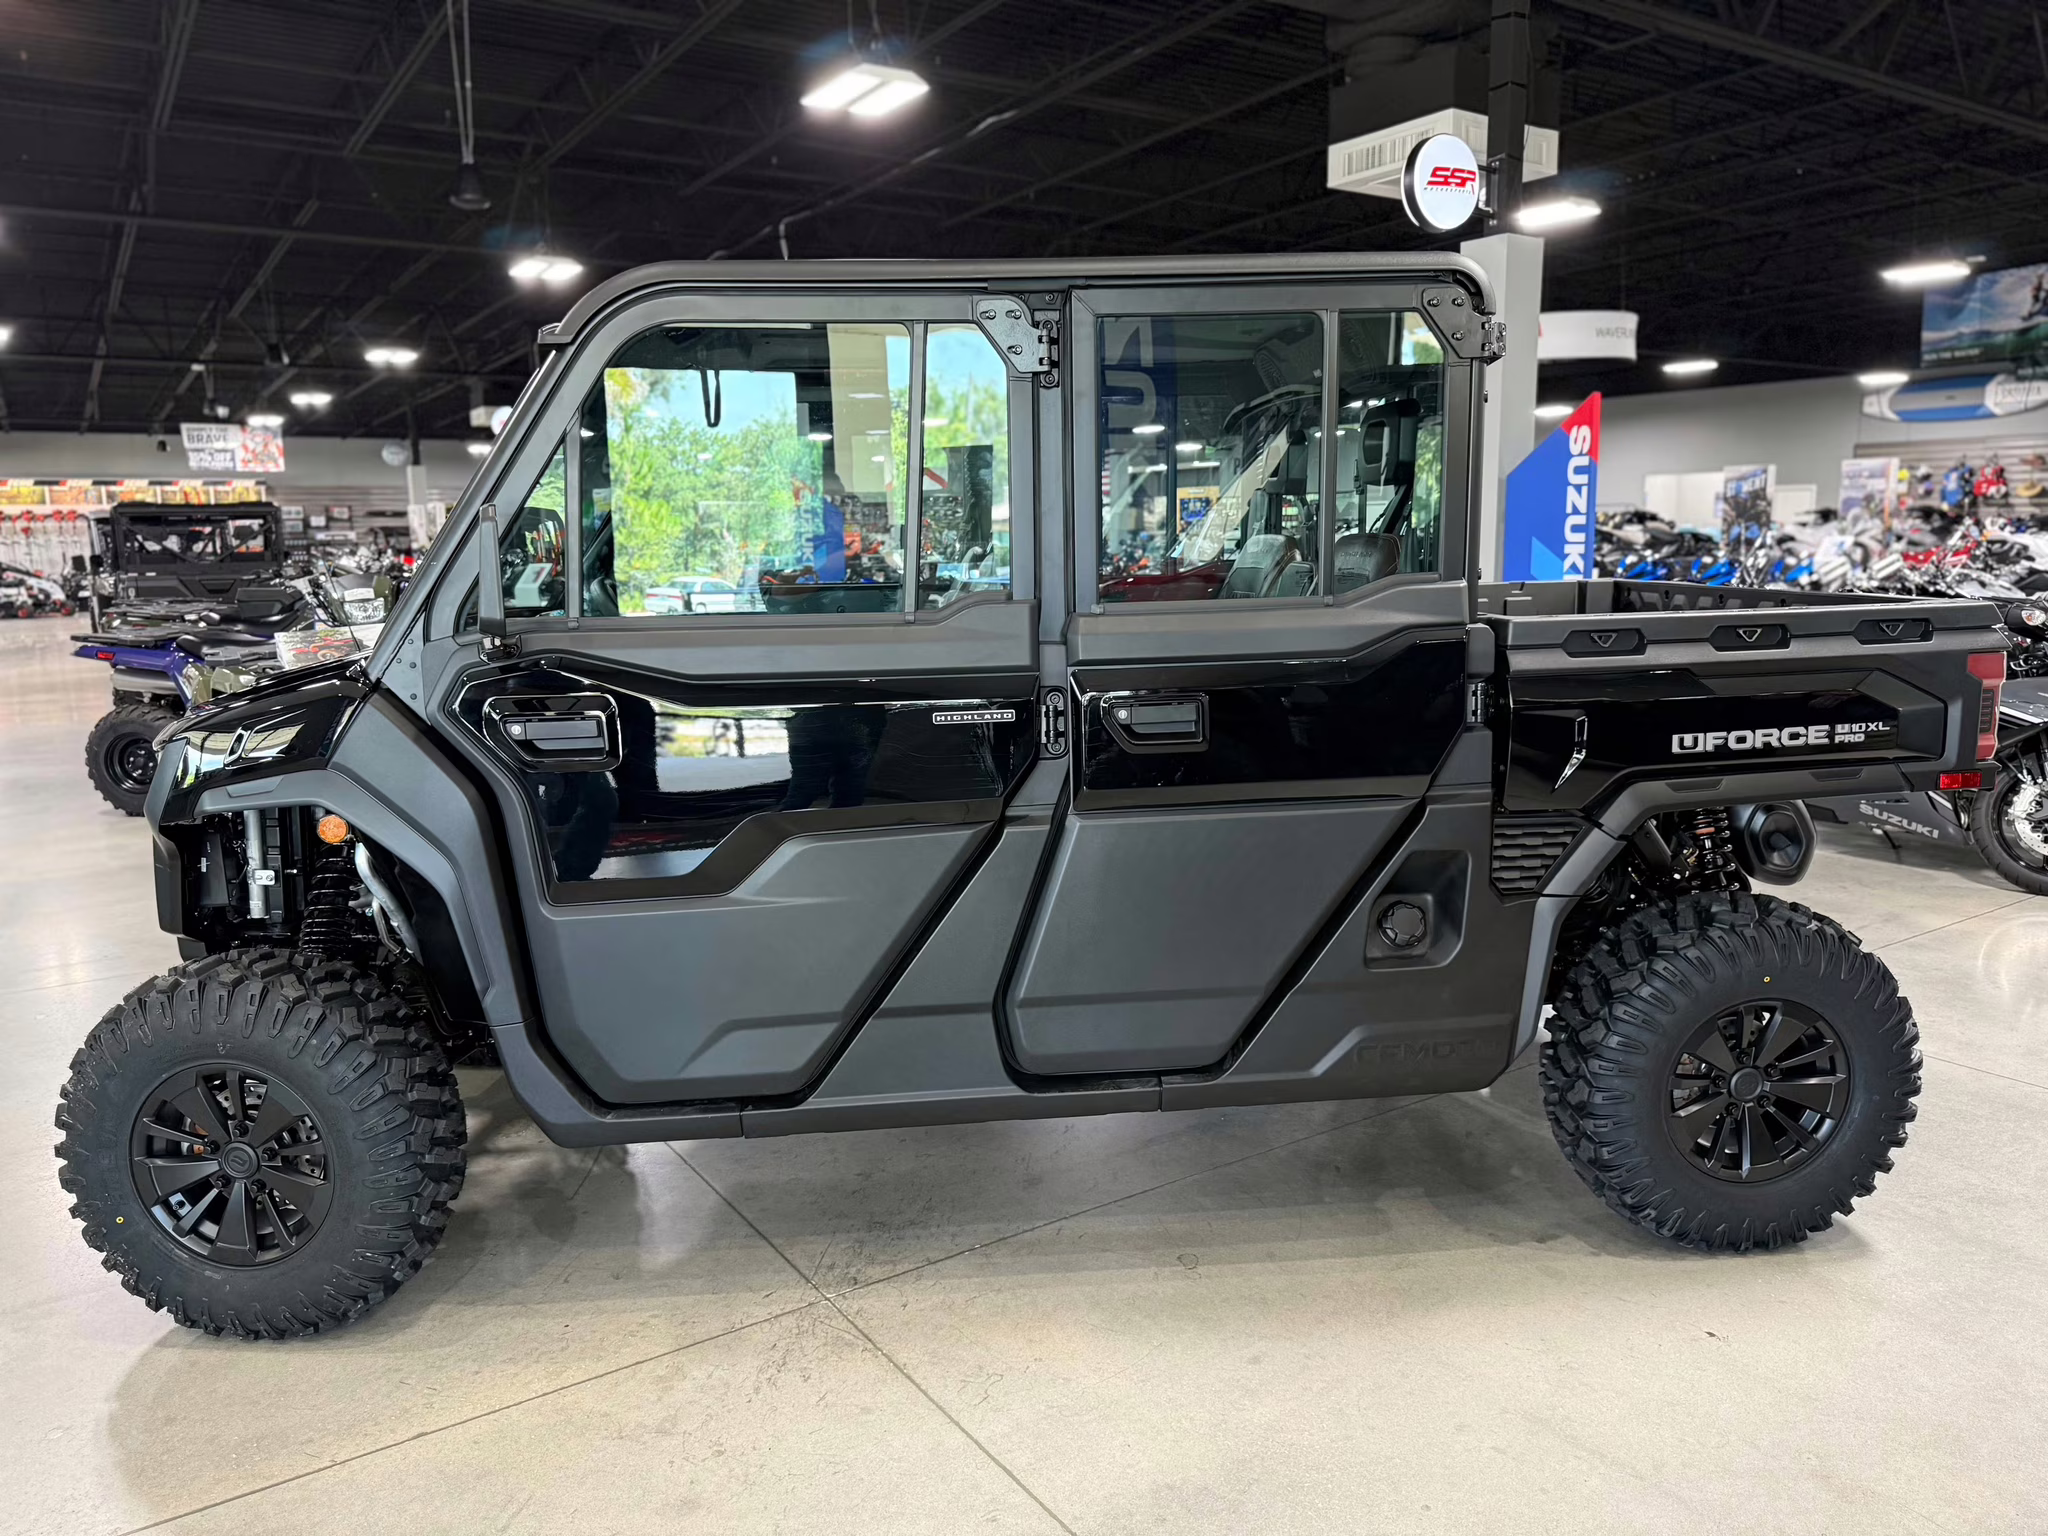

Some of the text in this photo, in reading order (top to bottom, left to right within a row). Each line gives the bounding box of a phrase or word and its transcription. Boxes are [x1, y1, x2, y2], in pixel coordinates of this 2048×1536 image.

[1426, 166, 1476, 190] SSR
[1563, 425, 1591, 580] SUZUKI
[936, 713, 1012, 721] HIGHLAND
[1672, 725, 1830, 754] UFORCE
[1834, 733, 1865, 744] PRO
[1859, 803, 1939, 839] SUZUKI
